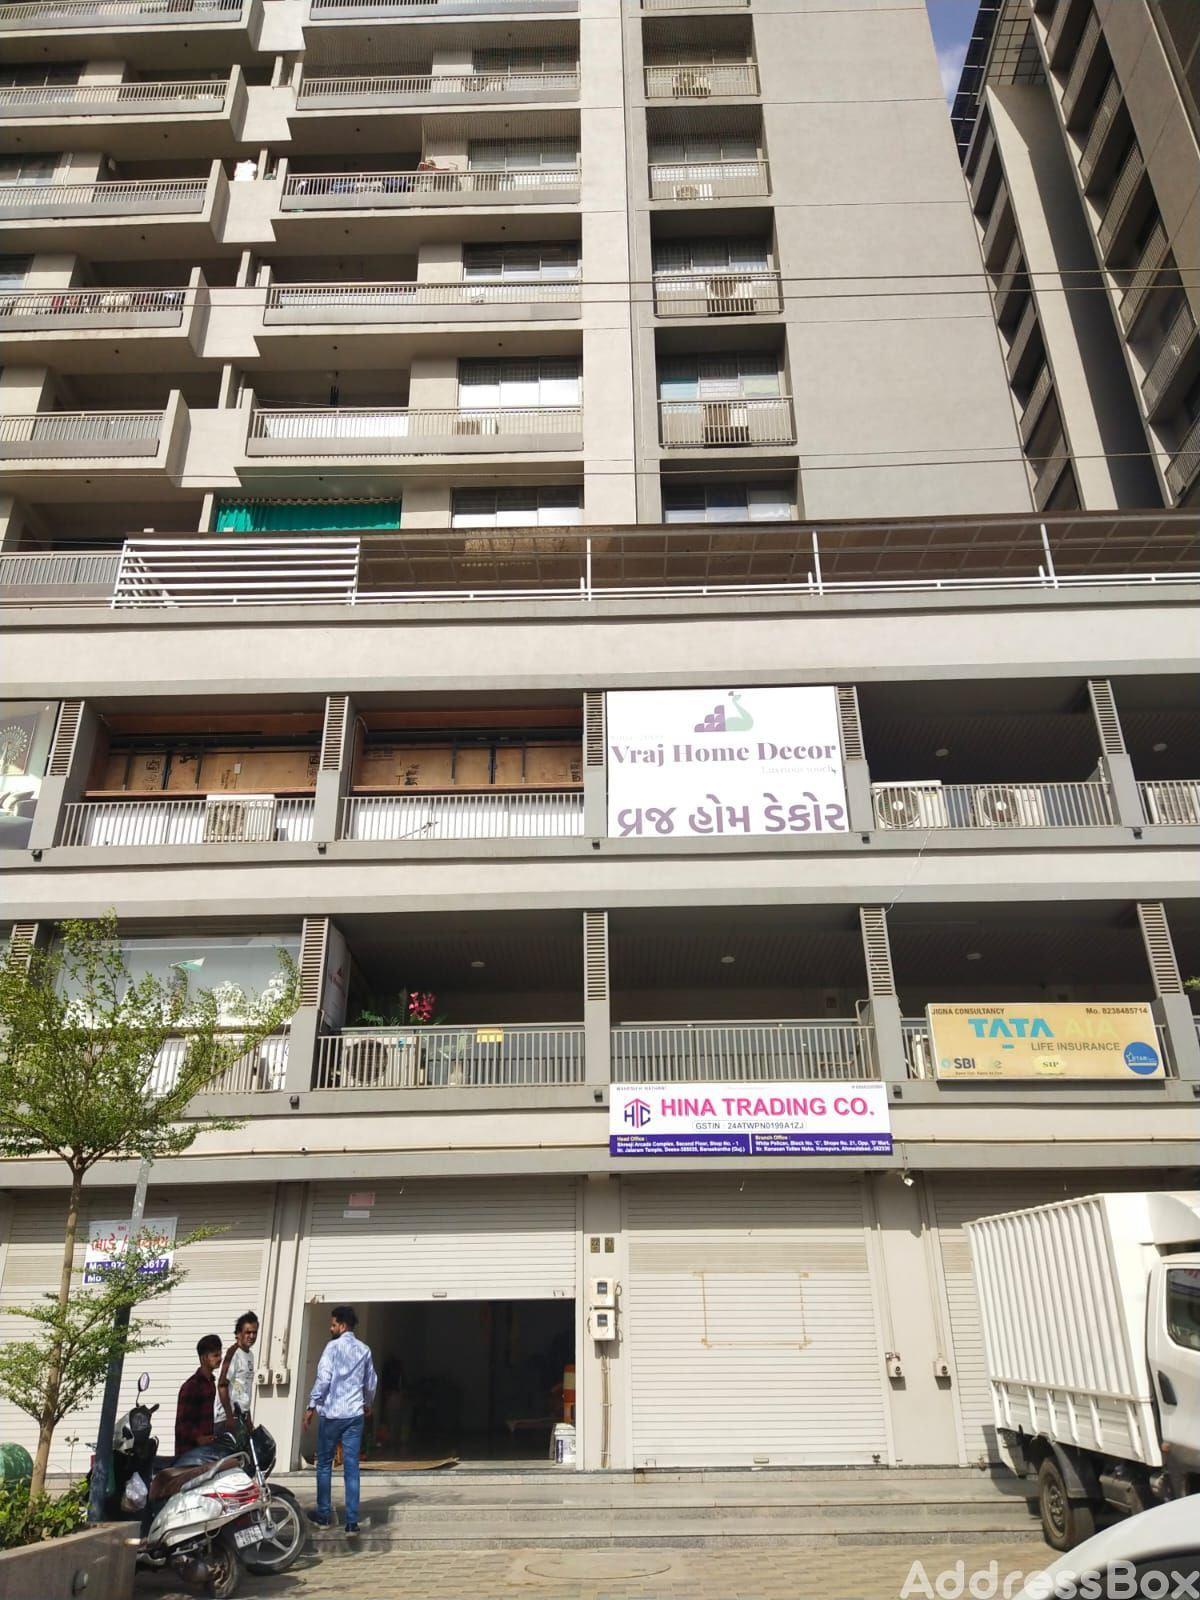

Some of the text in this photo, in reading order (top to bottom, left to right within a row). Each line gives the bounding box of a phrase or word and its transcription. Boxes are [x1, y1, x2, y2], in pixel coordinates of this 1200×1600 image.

[611, 742, 836, 767] Vraj Home Decor
[688, 794, 751, 833] હોમ
[763, 791, 845, 832] ડેકોર
[1085, 1007, 1100, 1015] Mo.
[967, 1018, 1119, 1038] TATA AIA
[1031, 1041, 1121, 1051] LIFE INSURANCE
[954, 1058, 976, 1069] SBI
[661, 1097, 875, 1117] HINA TRADING CO.
